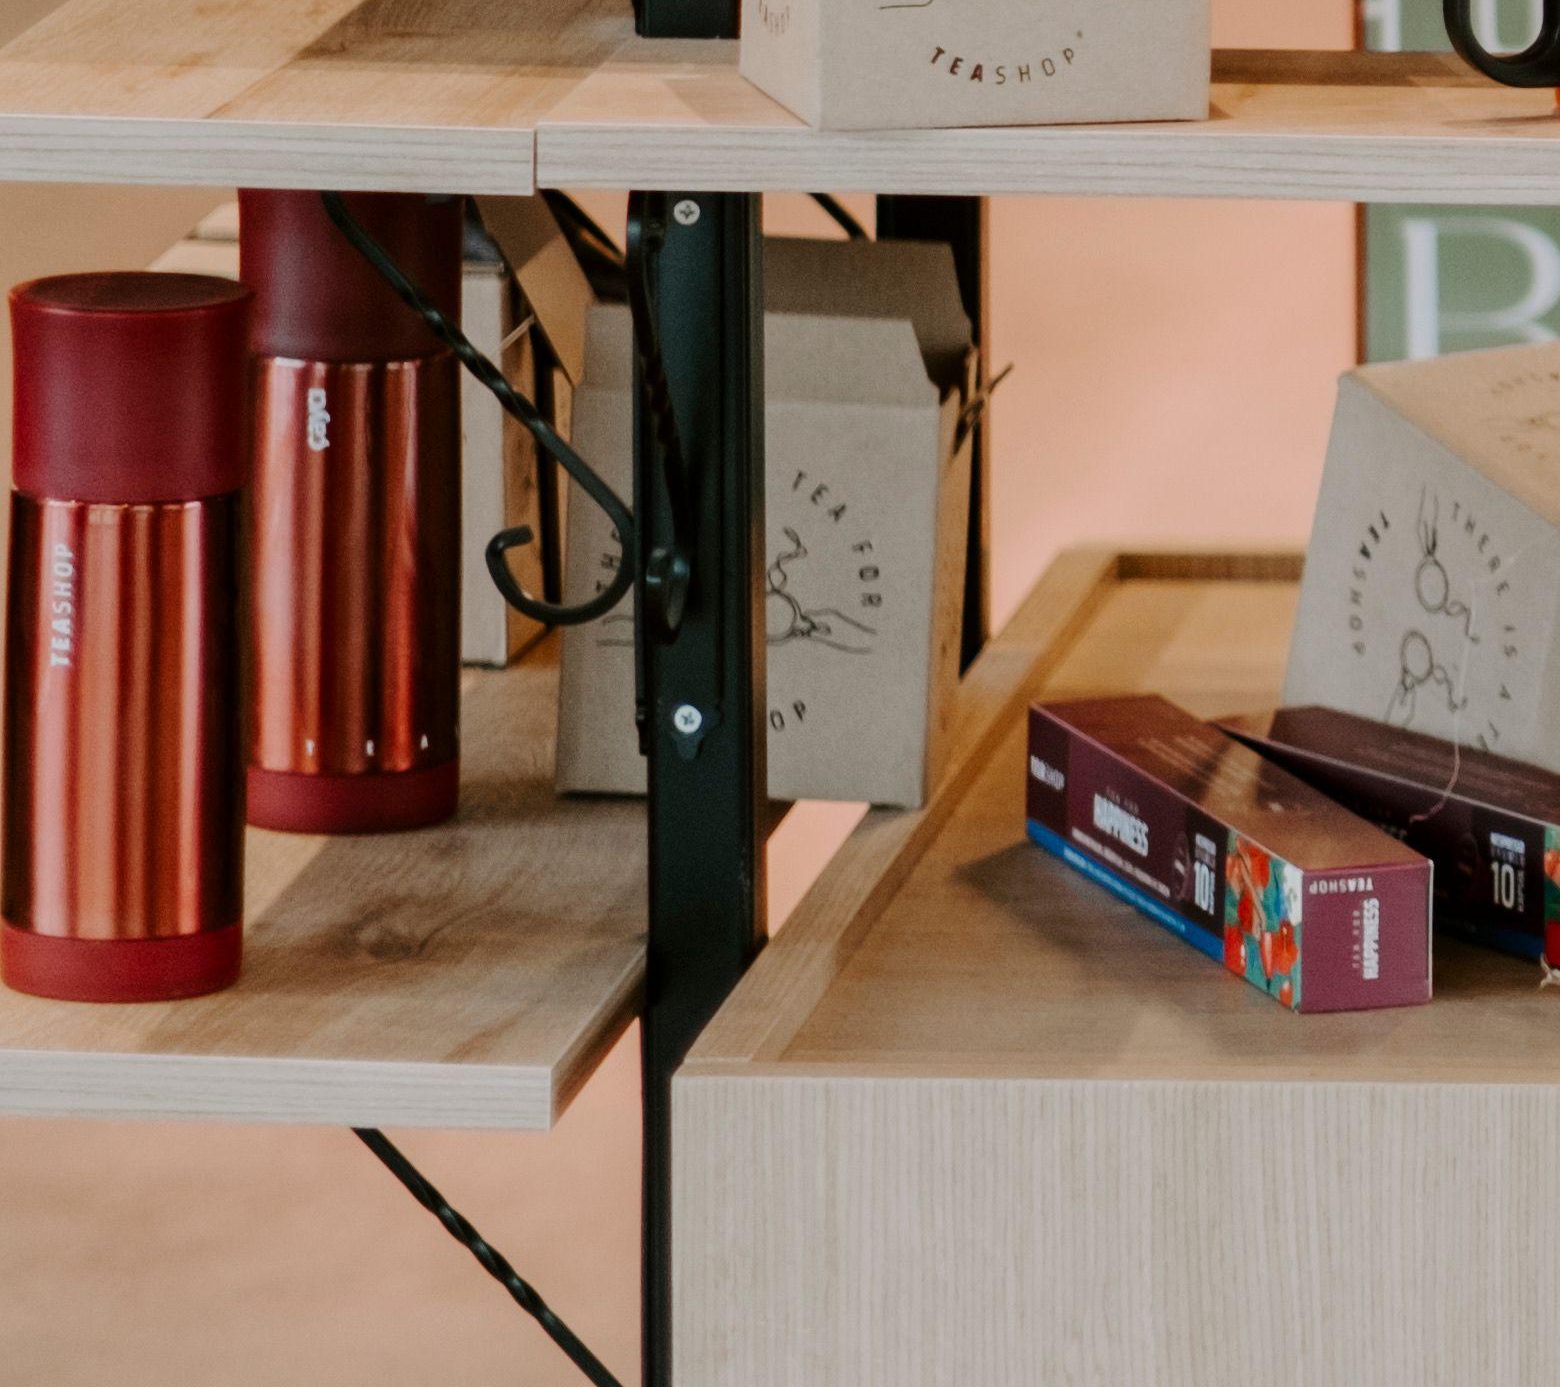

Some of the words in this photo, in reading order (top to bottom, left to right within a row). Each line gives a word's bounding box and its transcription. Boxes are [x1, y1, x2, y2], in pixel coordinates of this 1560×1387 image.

[929, 45, 1076, 85] TEASHOP
[792, 470, 847, 522] TEA
[851, 539, 883, 608] FOR
[1451, 500, 1511, 597] THERE
[1503, 625, 1519, 660] IS
[48, 540, 77, 671] TEASHOP
[1348, 509, 1391, 656] TEASHOP
[1193, 860, 1210, 912] 10
[1308, 876, 1374, 896] TEASHOP
[1489, 860, 1516, 910] 10
[1361, 897, 1381, 980] HAPPINESS
